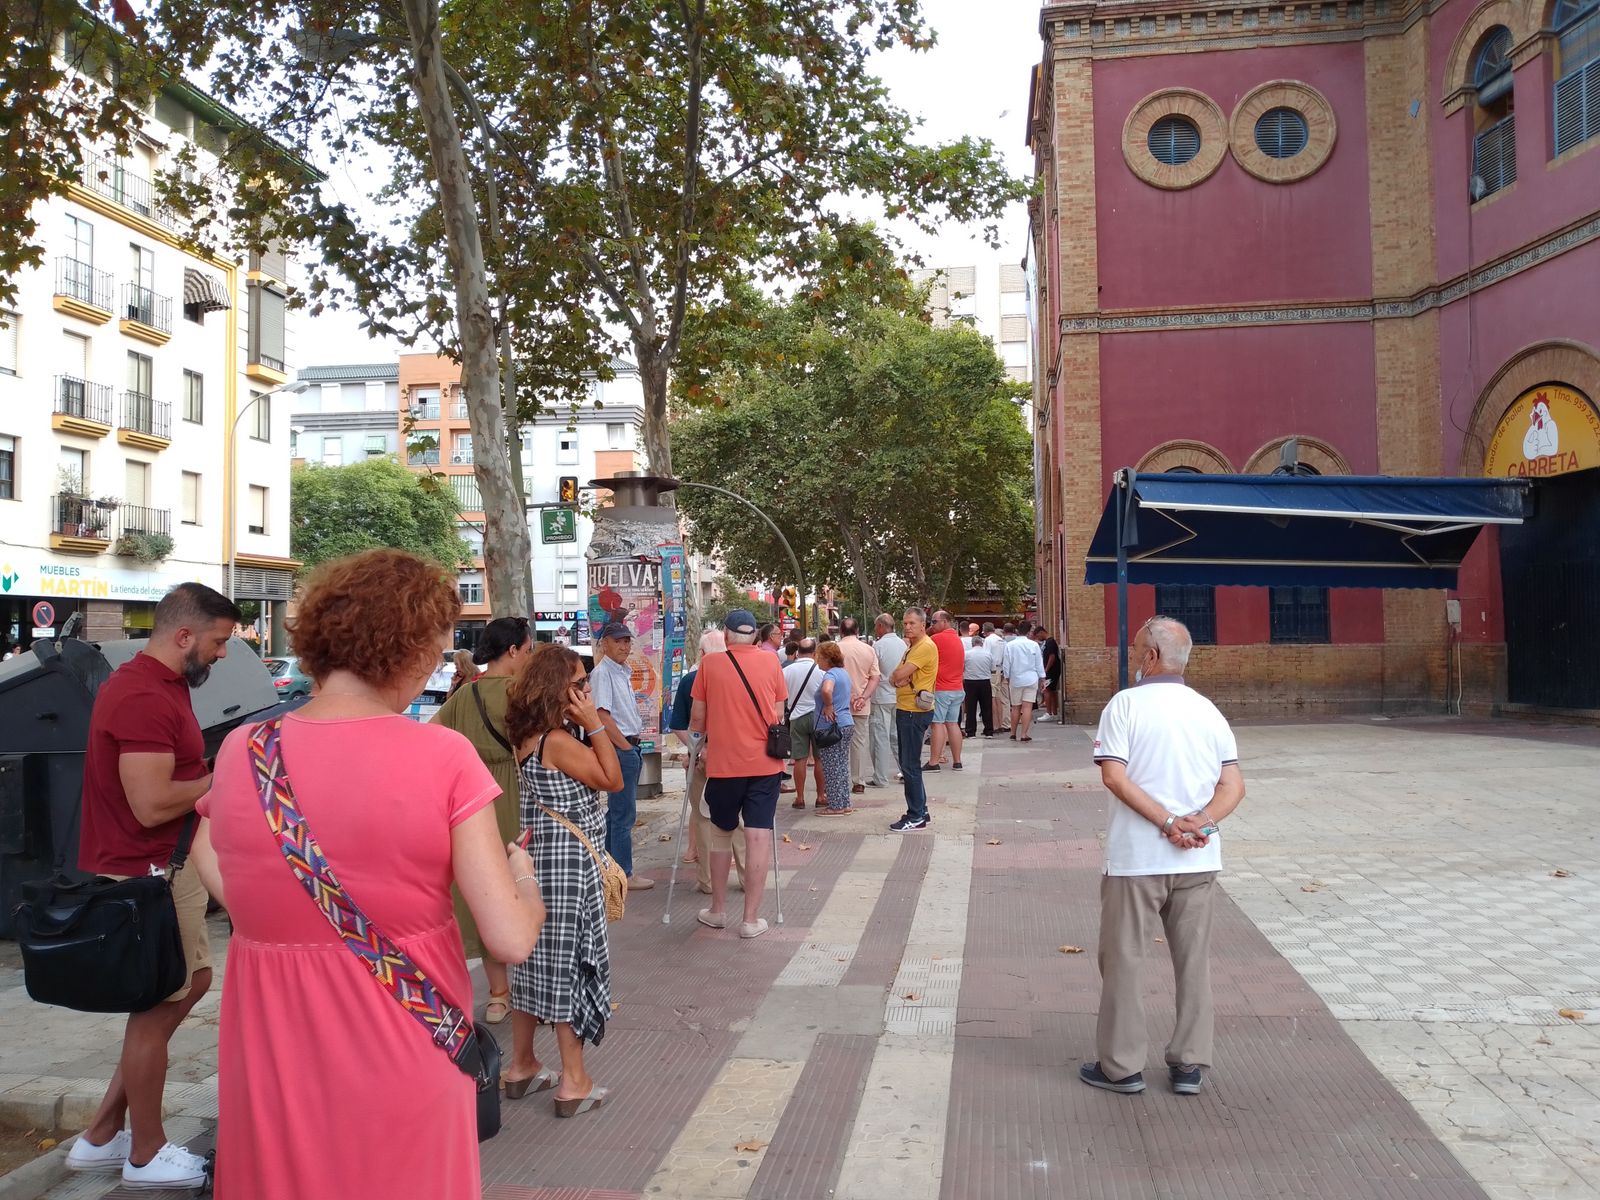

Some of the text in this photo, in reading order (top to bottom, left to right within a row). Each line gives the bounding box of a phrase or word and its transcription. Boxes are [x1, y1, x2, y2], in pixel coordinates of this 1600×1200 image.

[1497, 425, 1506, 438] de
[1505, 403, 1525, 426] Pollos
[1573, 397, 1588, 412] 959
[1585, 410, 1596, 424] 26
[1508, 450, 1579, 478] CARRETA
[40, 565, 80, 577] MUEBLES
[589, 564, 655, 587] HUELVA
[41, 576, 108, 597] MARTÍN
[110, 584, 119, 593] La
[120, 585, 139, 595] tienda
[140, 586, 150, 595] del
